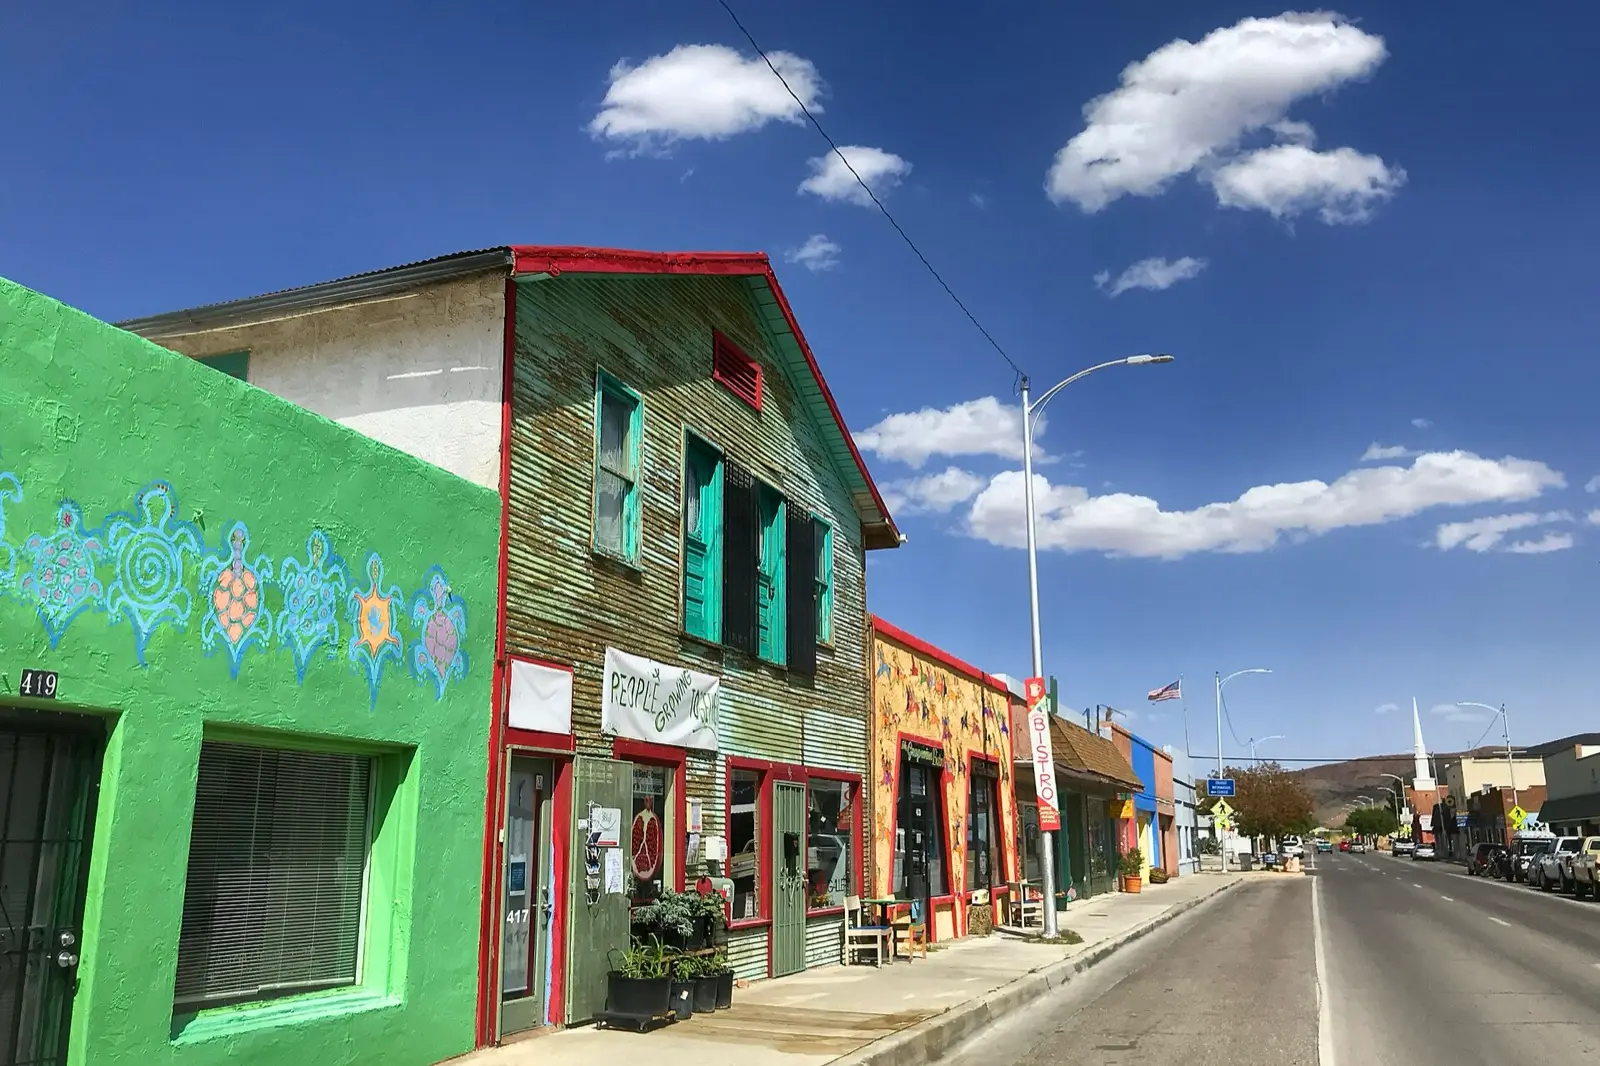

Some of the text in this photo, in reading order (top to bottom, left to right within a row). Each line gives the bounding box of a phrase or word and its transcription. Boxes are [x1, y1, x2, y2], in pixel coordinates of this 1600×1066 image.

[21, 672, 57, 696] 419
[611, 671, 660, 714] PEOPLE
[654, 669, 692, 732] GROWING
[1033, 717, 1054, 800] BISTRO
[506, 908, 529, 924] 417
